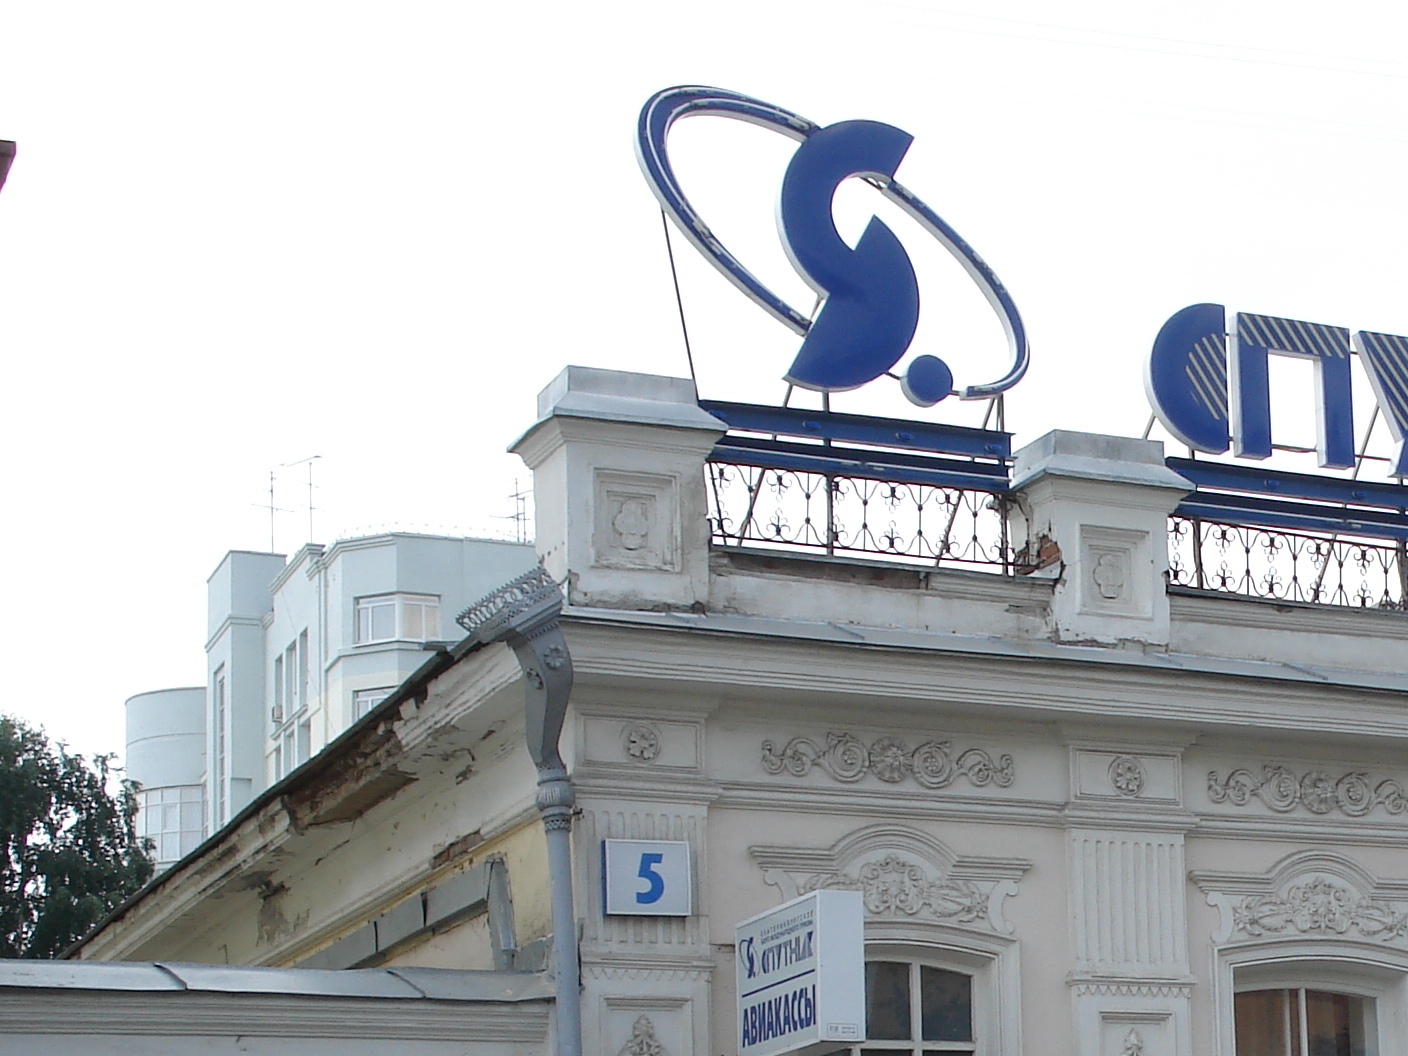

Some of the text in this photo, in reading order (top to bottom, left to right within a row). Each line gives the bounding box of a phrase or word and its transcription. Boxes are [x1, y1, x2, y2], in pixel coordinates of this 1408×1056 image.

[635, 852, 665, 904] 5
[761, 930, 814, 975] СПУТНИК
[742, 983, 817, 1049] АВИАКАССЫ
